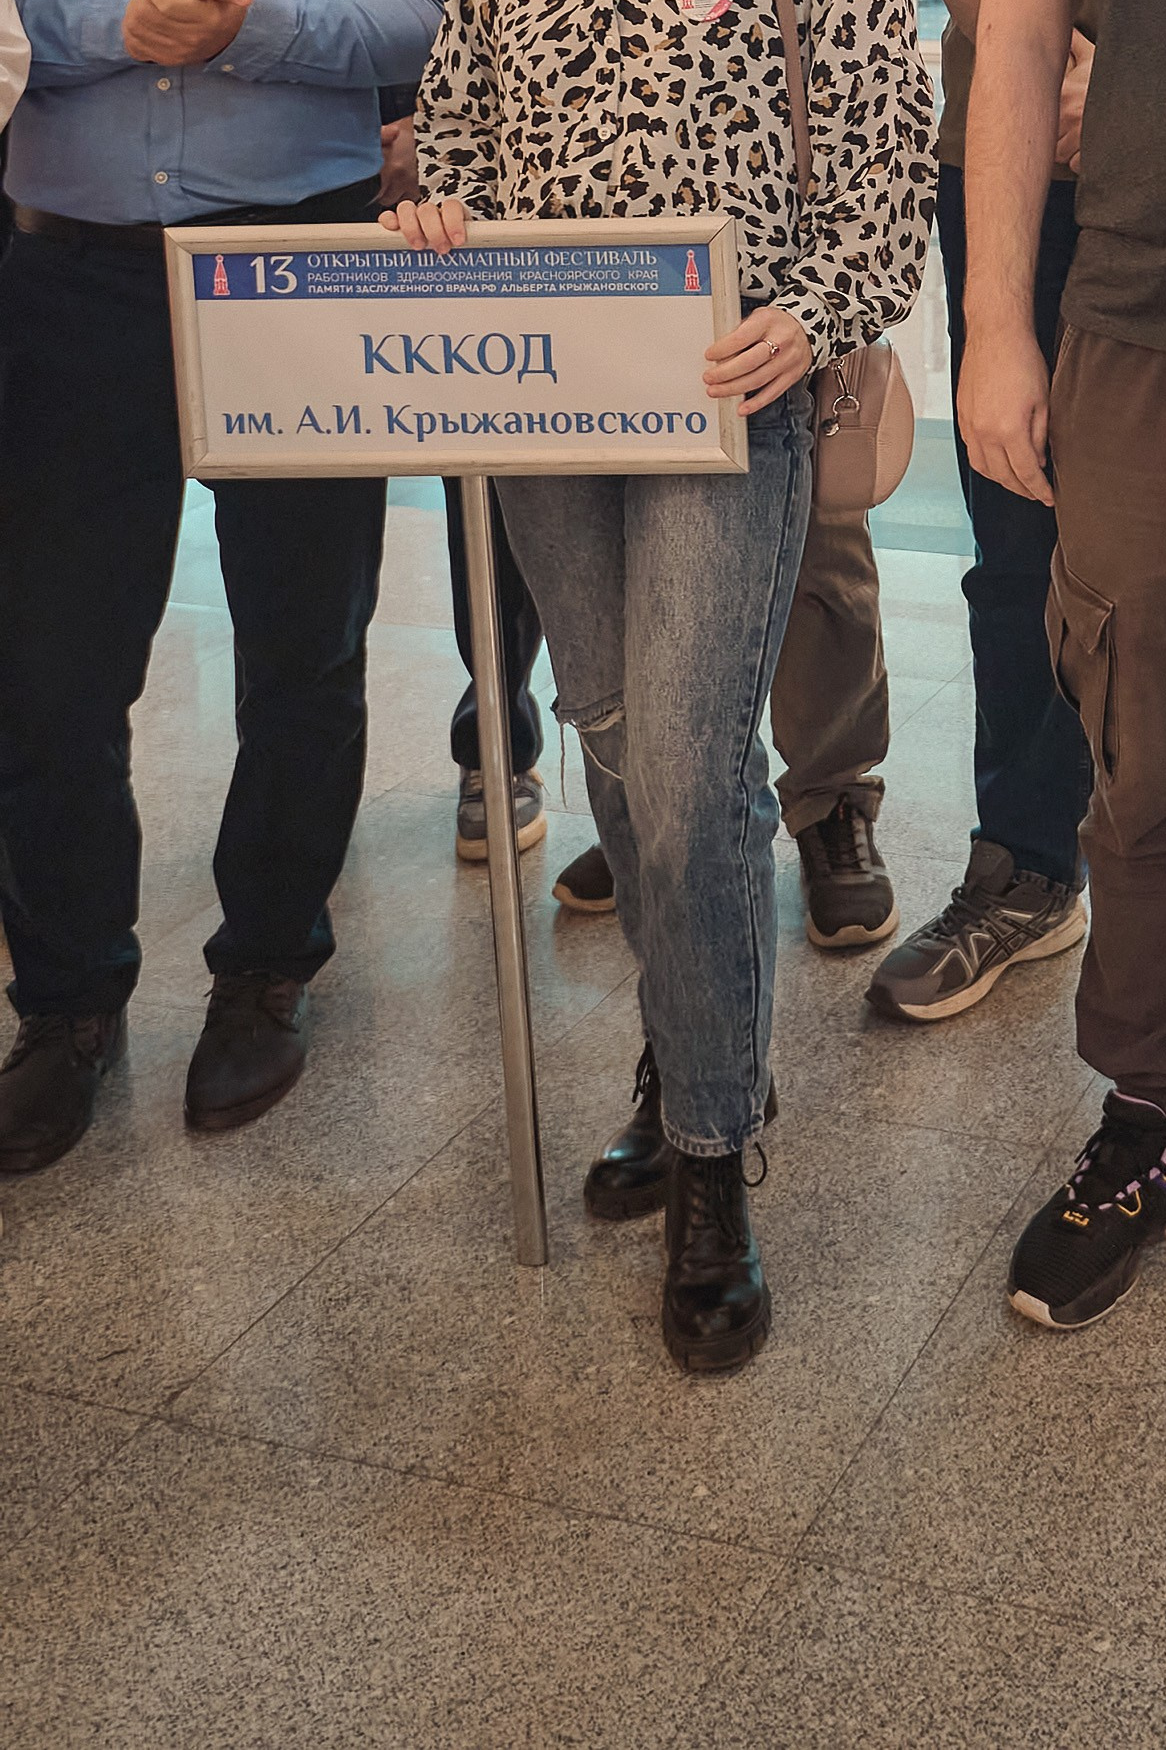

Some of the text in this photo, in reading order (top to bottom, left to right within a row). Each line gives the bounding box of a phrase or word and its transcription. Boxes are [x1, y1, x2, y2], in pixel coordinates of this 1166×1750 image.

[307, 250, 658, 268] ОТКРЫТЫЙ ШАХМАТНЫЙ ФЕСТИВАЛЬ
[250, 255, 297, 294] 13
[307, 269, 659, 283] РАБОТНИКОВ ЗДРАВООХРАНЕНИЯ КРАСНОЯРСКОГО КРАЯ
[308, 282, 659, 294] ПАМЯТИ ЗАСЛУЖЕННОГО ВРАЧА РФ АЛЬБЕРТА КРЫЖАНОВСКОГО
[359, 333, 558, 384] КККОД
[222, 404, 707, 442] им. А.И. Крыжановского
